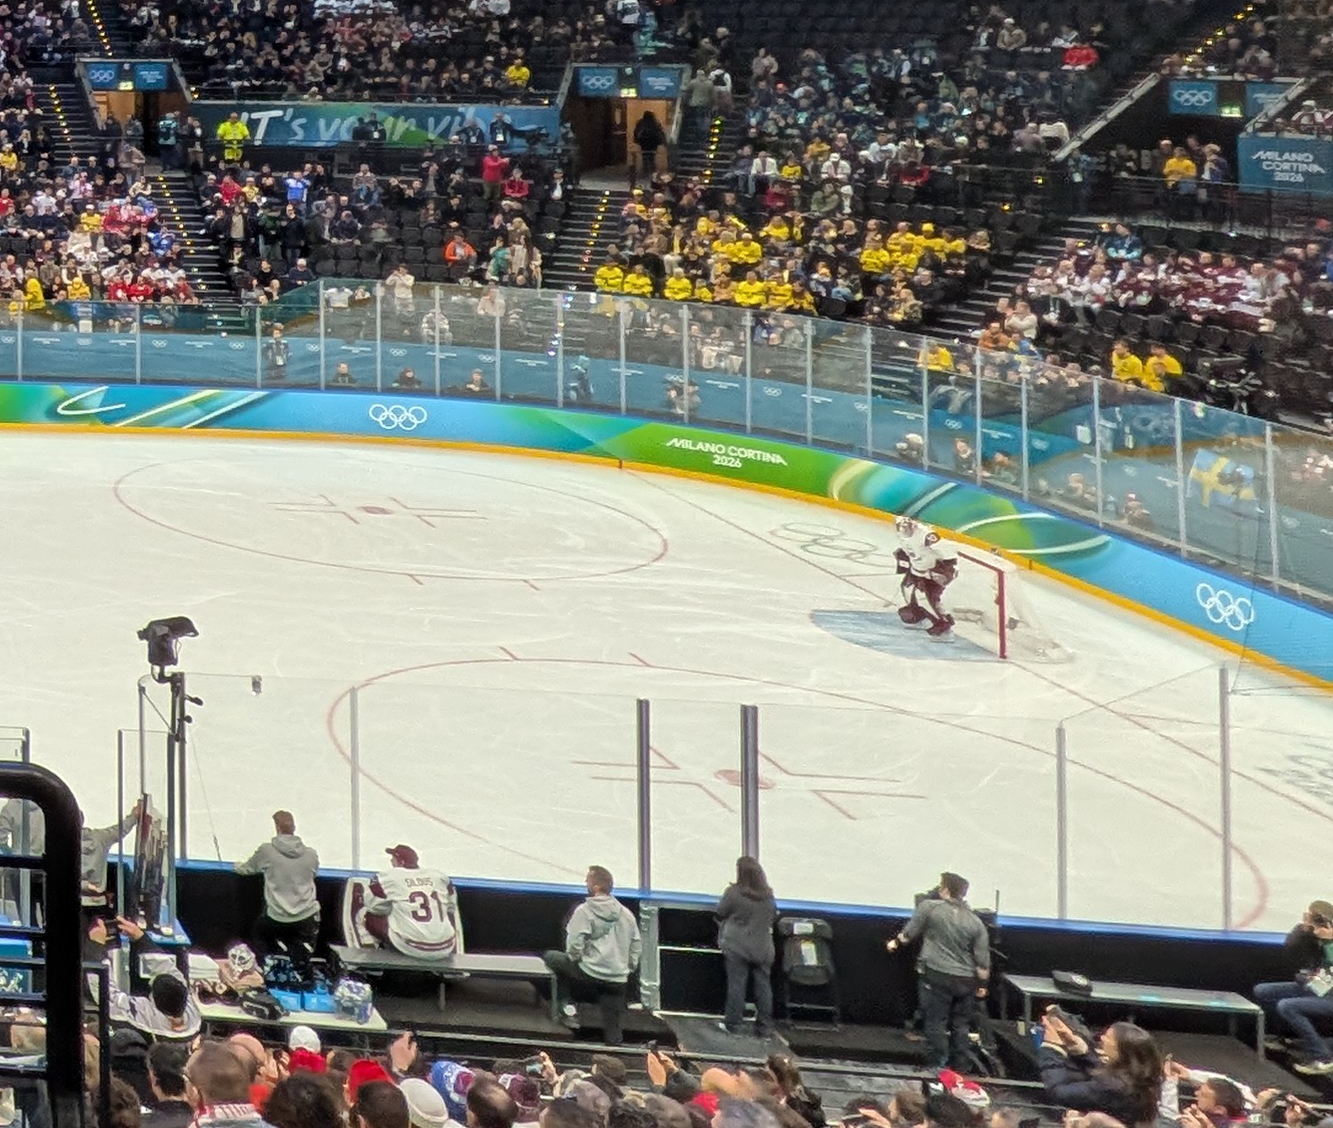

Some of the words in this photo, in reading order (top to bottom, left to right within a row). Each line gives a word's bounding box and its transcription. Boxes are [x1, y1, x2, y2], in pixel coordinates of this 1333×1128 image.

[317, 115, 416, 147] yor
[1251, 150, 1314, 162] MILANO
[1262, 161, 1326, 174] CORTINA
[666, 438, 726, 454] MILANO
[727, 445, 788, 466] CORTINA
[712, 454, 742, 468] 2026
[408, 890, 445, 923] 31
